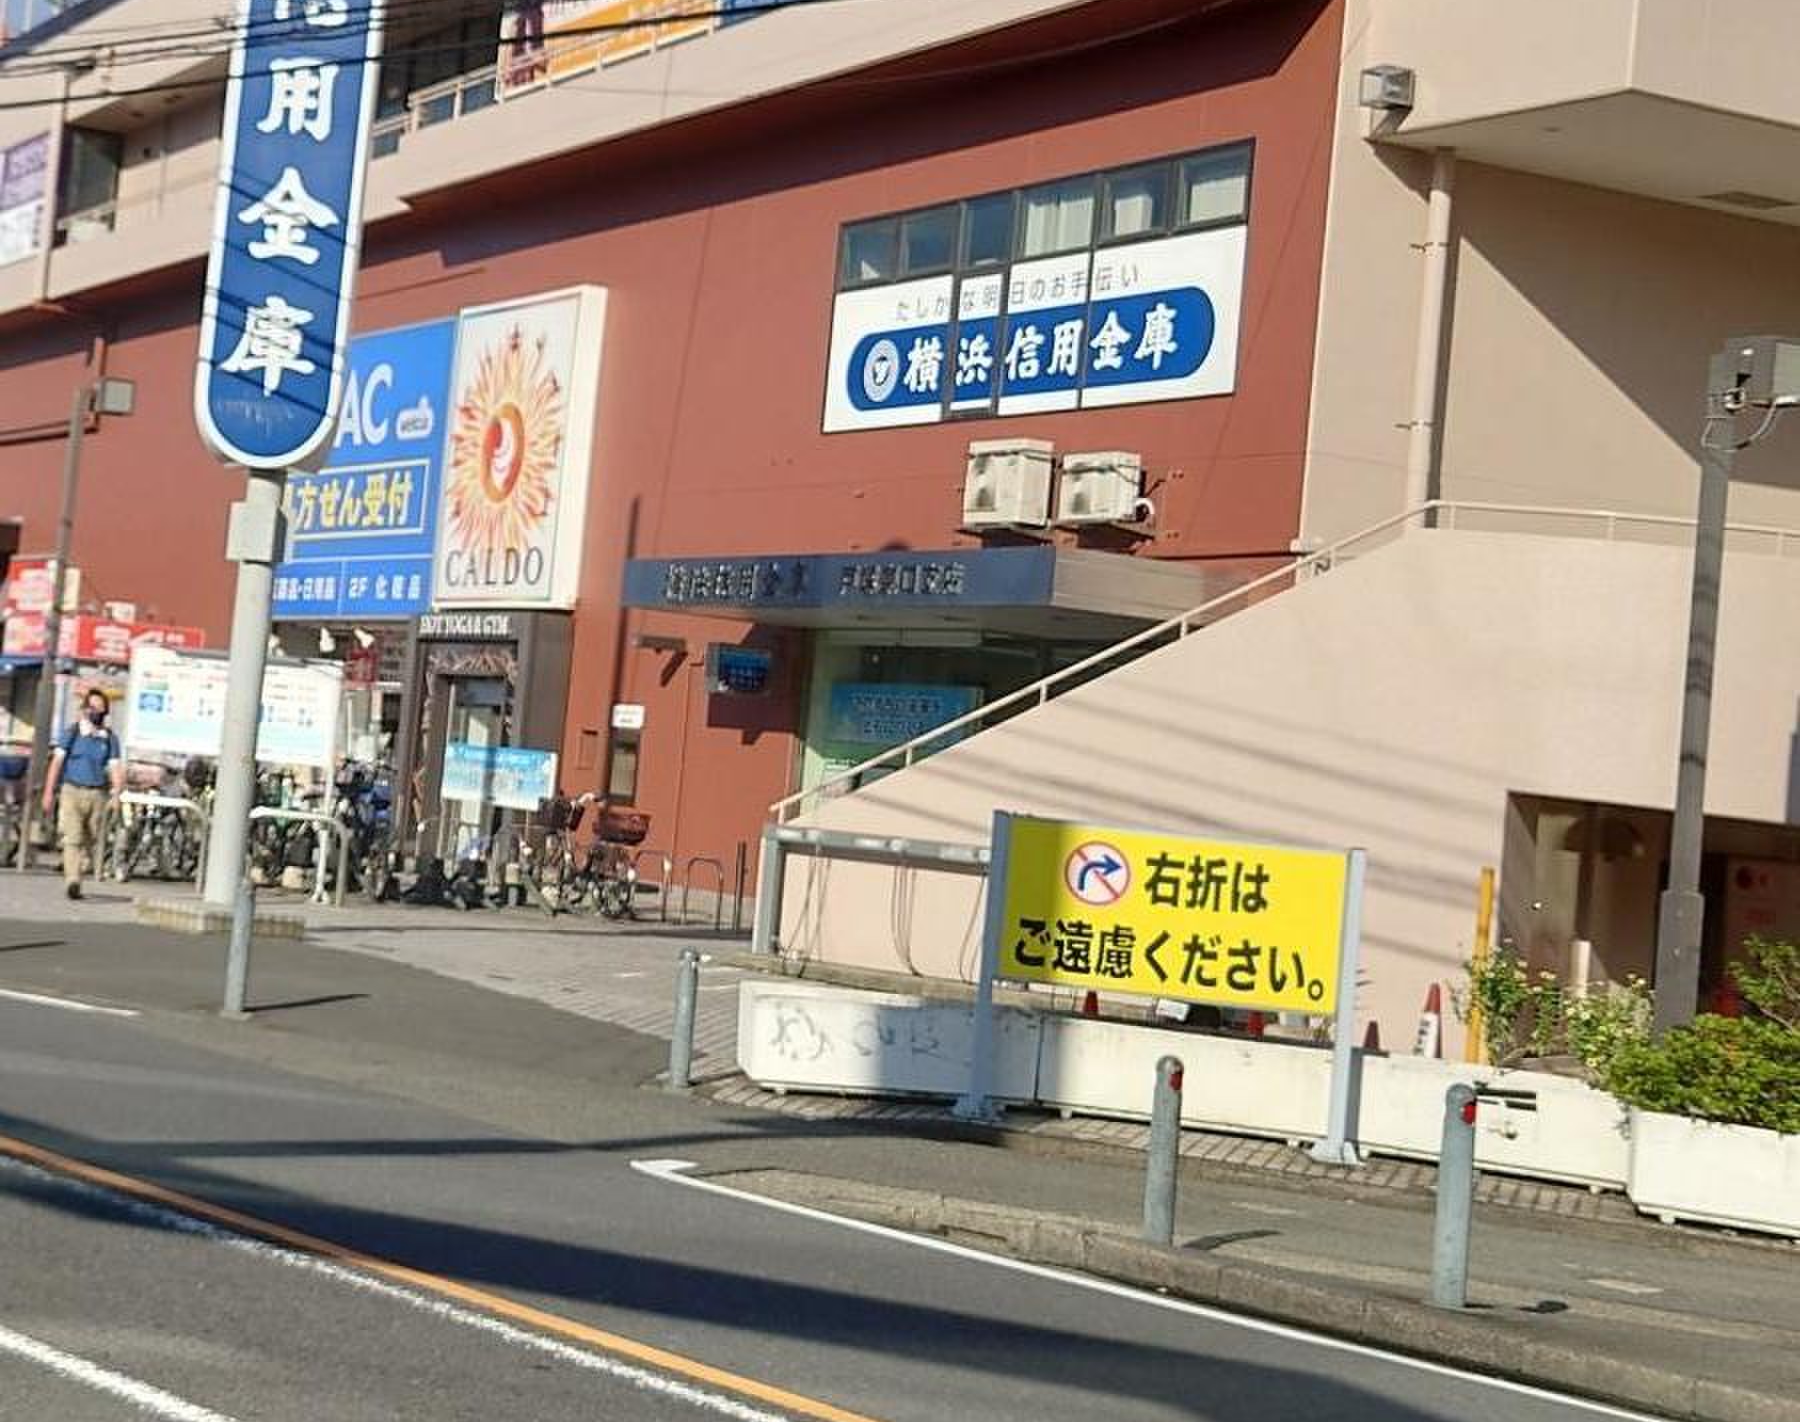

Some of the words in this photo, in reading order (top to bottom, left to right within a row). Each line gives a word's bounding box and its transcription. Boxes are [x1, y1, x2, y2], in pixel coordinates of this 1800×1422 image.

[903, 302, 1179, 393] 横浜信用金庫
[446, 547, 545, 590] CALDO
[1145, 852, 1270, 914] 右折は
[1015, 918, 1325, 1001] ご遠慮ください。
